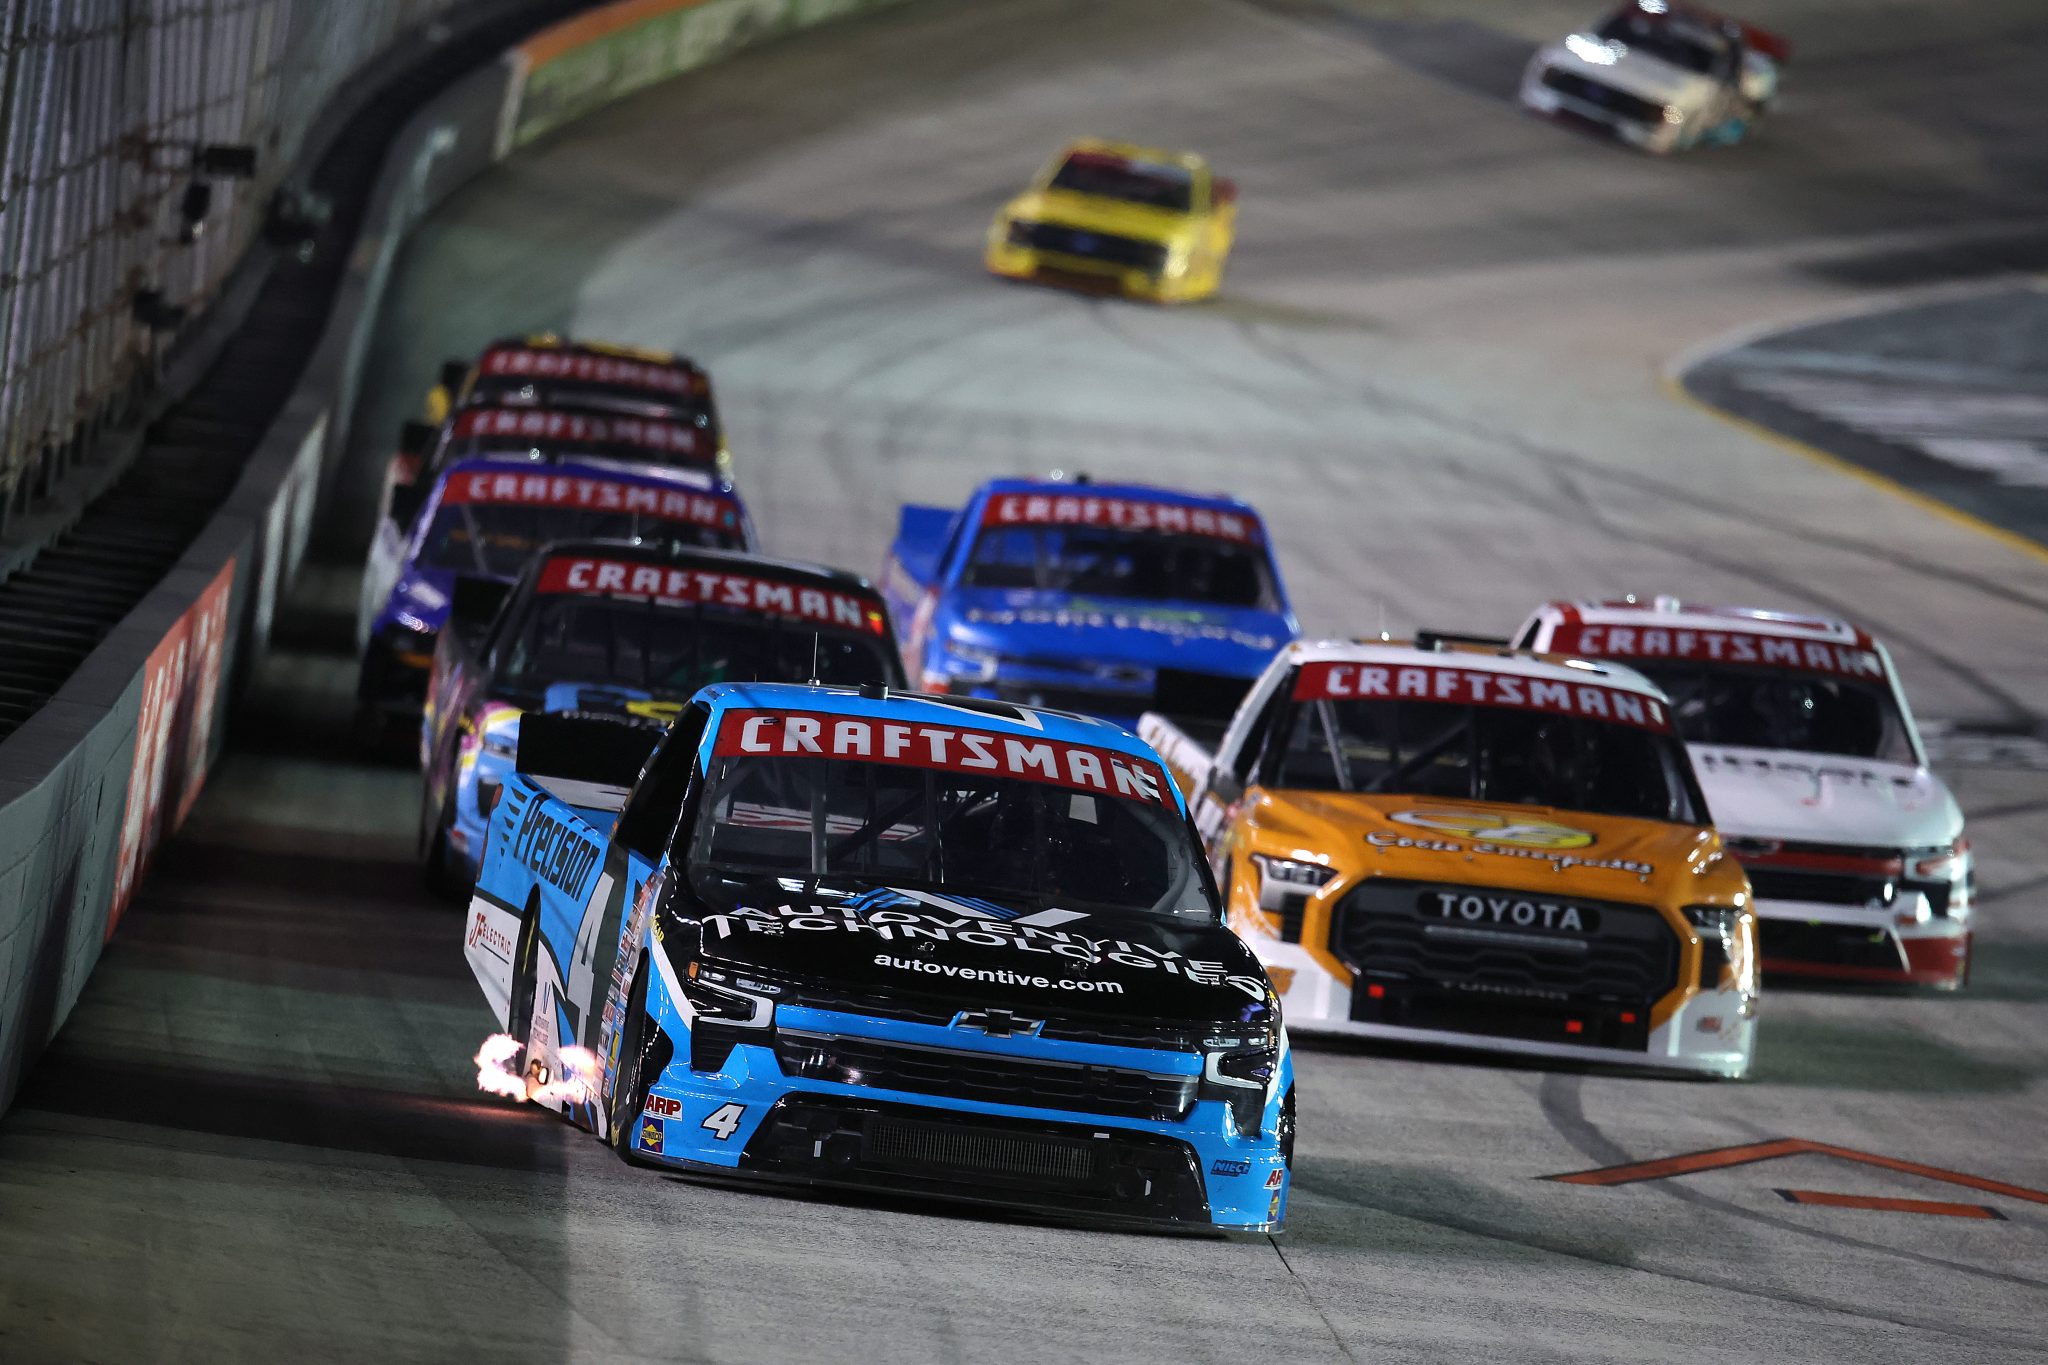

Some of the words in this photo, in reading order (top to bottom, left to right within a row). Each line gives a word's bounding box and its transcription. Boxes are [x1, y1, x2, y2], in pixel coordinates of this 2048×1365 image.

[468, 474, 718, 521] CRAFTSMAN
[1001, 496, 1247, 539] CRAFTSMAN
[567, 561, 862, 628] CRAFTSMAN
[1577, 627, 1870, 677] CRAFTSMAN
[1326, 666, 1645, 725] CRAFTSMAN
[740, 716, 1160, 801] CRAFTSMAN
[513, 793, 601, 902] Precision
[1436, 892, 1583, 931] TOYOTA
[873, 953, 1124, 994] autoventive.com
[645, 1094, 682, 1116] ARP
[702, 1102, 748, 1141] 4
